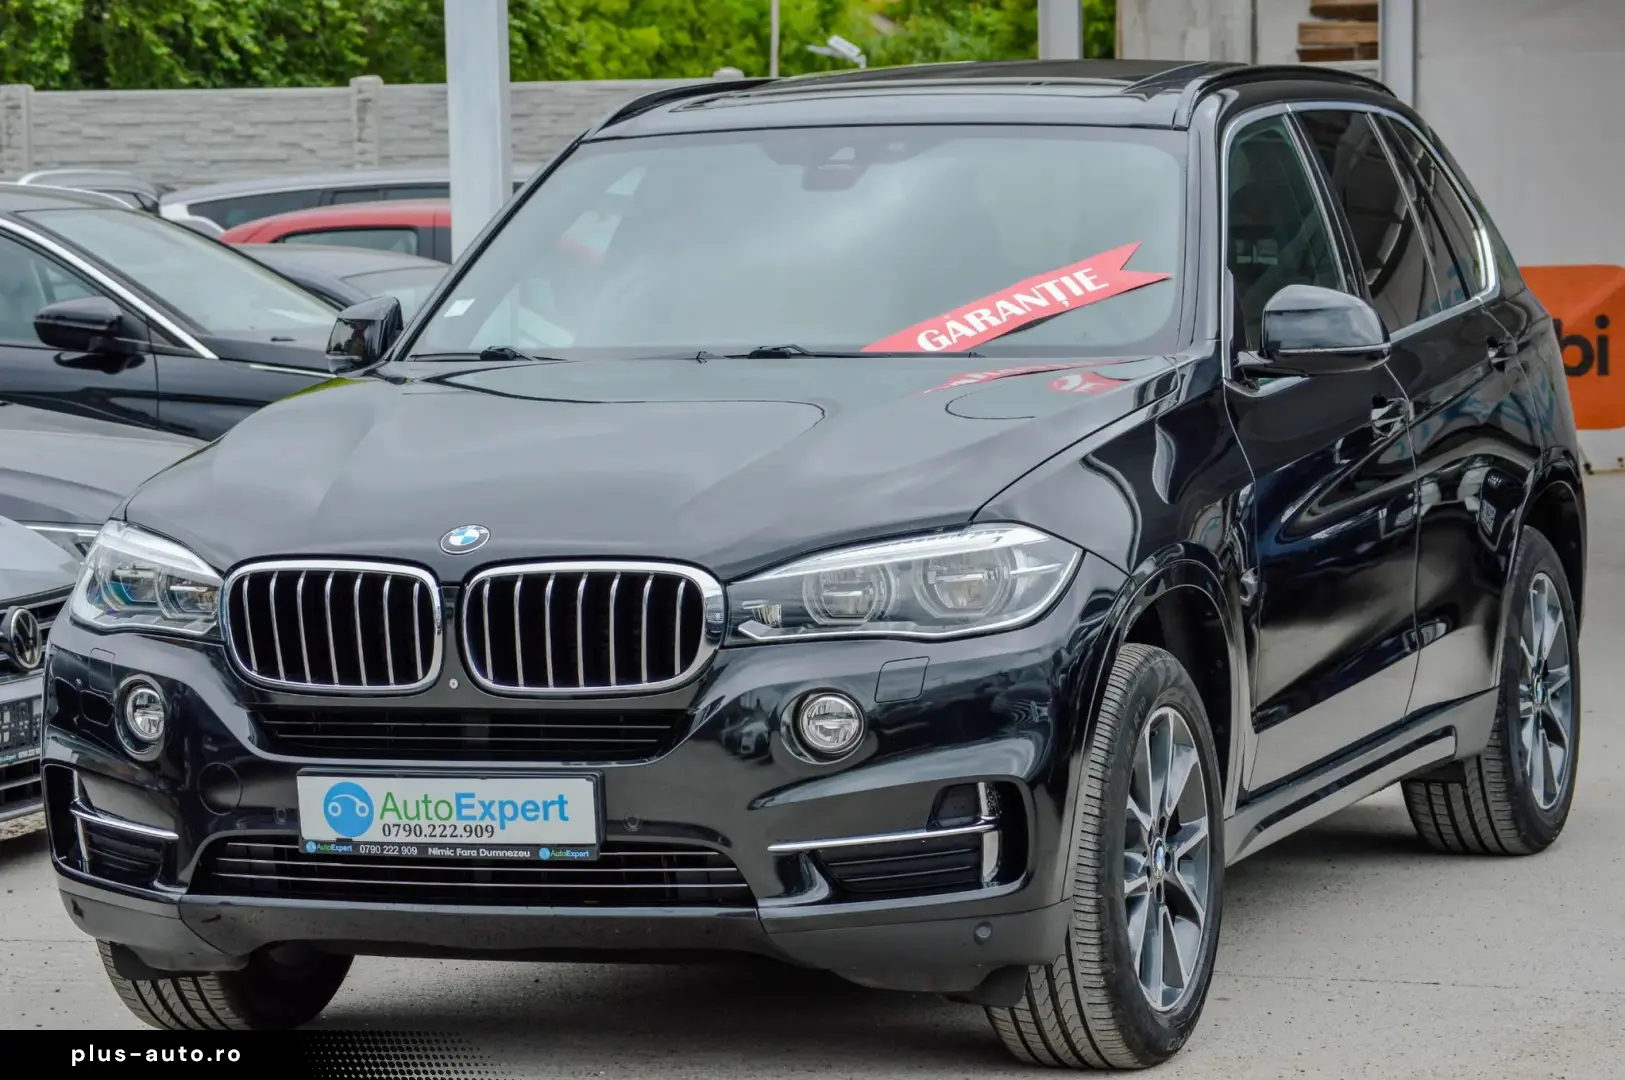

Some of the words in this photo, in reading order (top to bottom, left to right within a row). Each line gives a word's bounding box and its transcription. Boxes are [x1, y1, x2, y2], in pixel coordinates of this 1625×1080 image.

[379, 791, 570, 830] AutoExpert
[382, 823, 495, 839] 0790.222.909
[316, 843, 353, 853] AutoExpert
[359, 844, 381, 854] 0790
[383, 845, 399, 855] 222
[401, 846, 418, 856] 909
[428, 847, 455, 856] Nimic
[456, 848, 477, 857] Fara
[479, 849, 531, 858] Dumnezeu
[550, 849, 589, 859] AutoExpert
